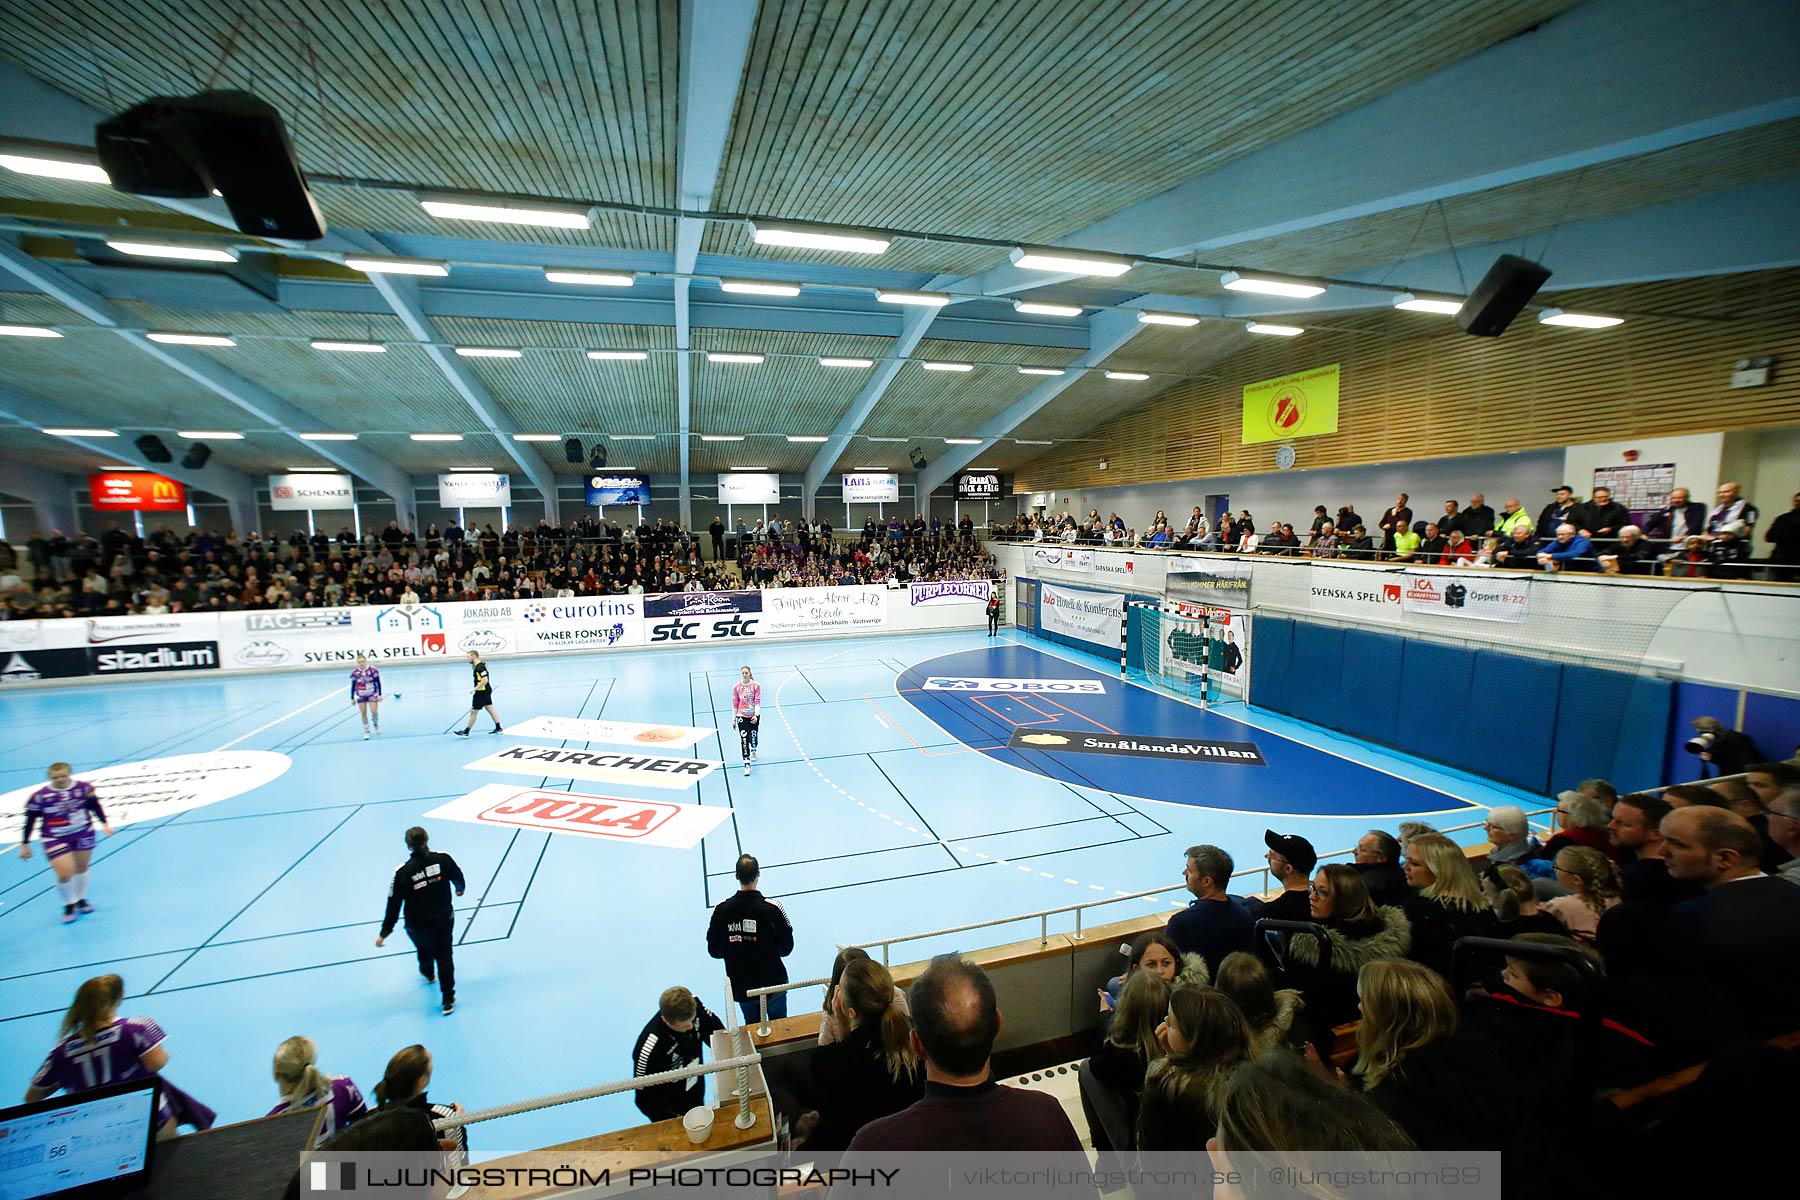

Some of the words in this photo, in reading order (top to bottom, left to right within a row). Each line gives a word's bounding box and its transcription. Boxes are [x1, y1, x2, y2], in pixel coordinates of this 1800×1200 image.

[297, 488, 350, 497] SCHENKER
[1095, 564, 1114, 573] SVENSKA
[1114, 566, 1126, 574] SPEL
[1414, 578, 1434, 591] ICA
[911, 581, 990, 605] PURPLECORNER
[1311, 587, 1354, 600] SVENSKA
[1357, 591, 1381, 603] SPEL
[1502, 594, 1525, 604] 8-22
[500, 607, 511, 617] AB
[553, 600, 635, 619] eurofins
[1076, 600, 1082, 611] &
[1084, 600, 1122, 618] Konferens
[250, 612, 293, 629] IAC
[651, 617, 700, 642] stc
[711, 614, 759, 638] stc
[98, 647, 214, 671] stadium
[304, 649, 378, 662] SVENSKA
[383, 646, 420, 658] SPEL
[990, 682, 1101, 693] OBOS
[1084, 736, 1259, 760] SmålandsVillan
[498, 747, 709, 775] KÄRCHER
[495, 797, 658, 831] JULA
[49, 1144, 68, 1159] 56
